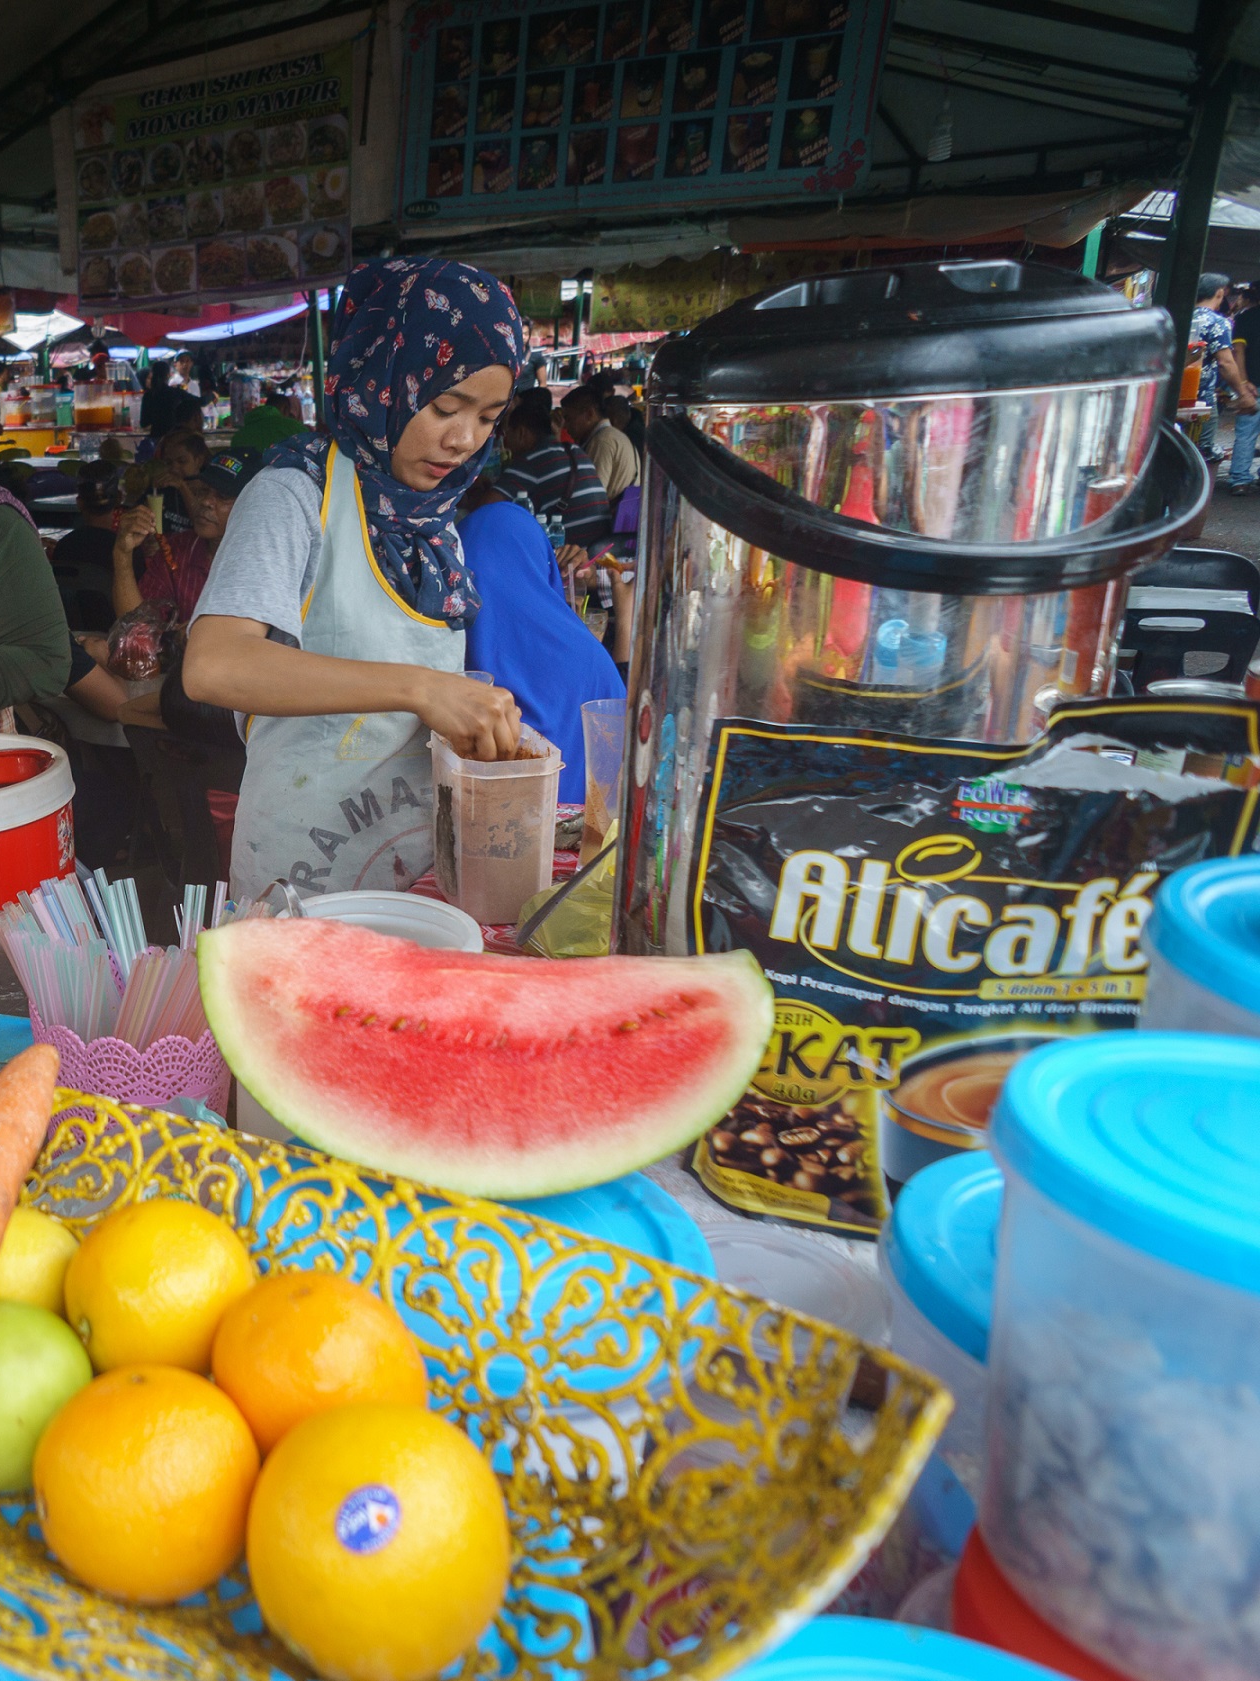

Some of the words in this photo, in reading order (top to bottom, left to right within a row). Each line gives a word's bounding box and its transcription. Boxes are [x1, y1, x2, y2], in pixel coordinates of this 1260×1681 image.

[139, 80, 205, 110] GERAI
[210, 70, 254, 96] SRI
[257, 52, 325, 86] RASA
[124, 102, 230, 142] MONGGO
[231, 77, 342, 121] MAMPIR
[799, 136, 829, 159] KELAPA
[801, 145, 834, 167] PANDAN
[407, 204, 437, 214] HALAL
[957, 780, 1037, 809] POWER
[959, 807, 1024, 827] ROOT
[768, 850, 1158, 976] Alicafé
[764, 968, 798, 986] Kopi
[800, 975, 885, 1002] Pracampur
[888, 994, 949, 1013] dengan
[954, 1002, 1016, 1017] Tongkat
[1019, 1002, 1041, 1014] Ali
[1044, 1003, 1076, 1015] dan
[1104, 980, 1117, 994] in
[775, 1012, 814, 1027] EBIH
[758, 1030, 910, 1083] KAT
